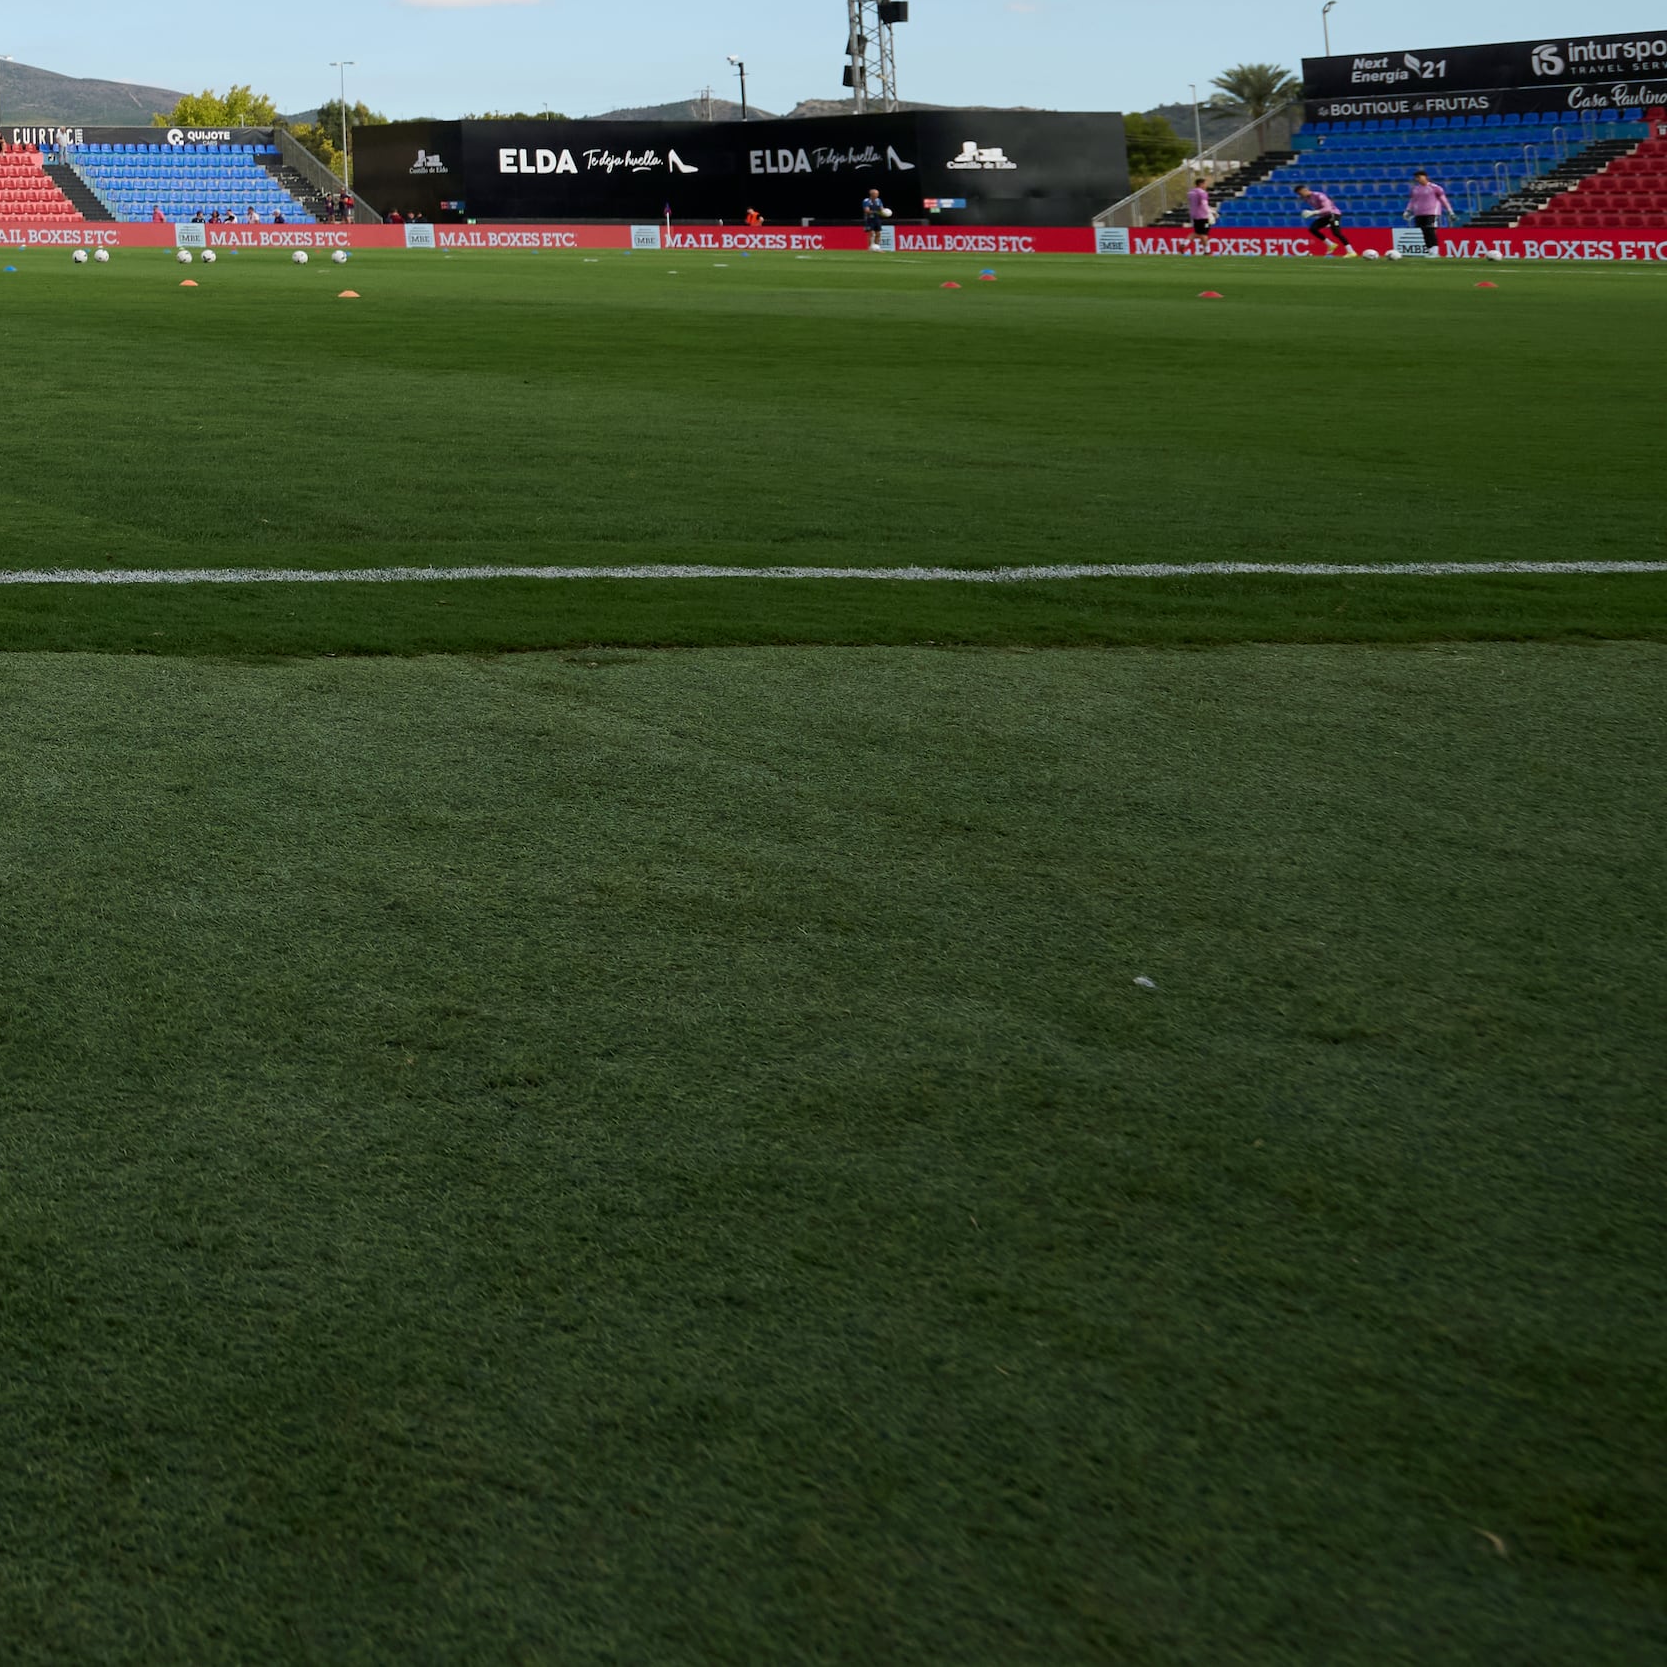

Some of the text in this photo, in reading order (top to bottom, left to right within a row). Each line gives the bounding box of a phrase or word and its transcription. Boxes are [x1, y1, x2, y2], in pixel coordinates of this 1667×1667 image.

[1353, 57, 1389, 70] Next
[1422, 60, 1446, 78] 21
[1570, 64, 1624, 75] TRAVEL
[1351, 69, 1409, 83] Energía
[1331, 101, 1410, 116] BOUTIQUE
[1426, 96, 1489, 111] FRUTAS
[1568, 87, 1608, 108] Casa
[13, 128, 73, 145] CUIRTC
[188, 131, 230, 141] QUIJOTE
[499, 148, 578, 174] ELDA
[583, 149, 601, 170] Te
[598, 150, 623, 174] deja
[750, 149, 812, 174] ELDA
[812, 147, 827, 166] Te
[824, 149, 848, 171] deja
[28, 229, 81, 244] BOXES
[84, 229, 120, 244] ETC.
[210, 231, 350, 246] MAIL BOXES ETC.
[439, 233, 577, 247] MAIL BOXES ETC.
[665, 234, 824, 249] MAIL BOXES ETC.
[898, 235, 1036, 253] MAIL BOXES ETC.
[1194, 238, 1262, 256] BOXES
[1264, 238, 1312, 256] ETC.
[1444, 240, 1520, 260] MAIL
[1523, 240, 1614, 260] BOXES
